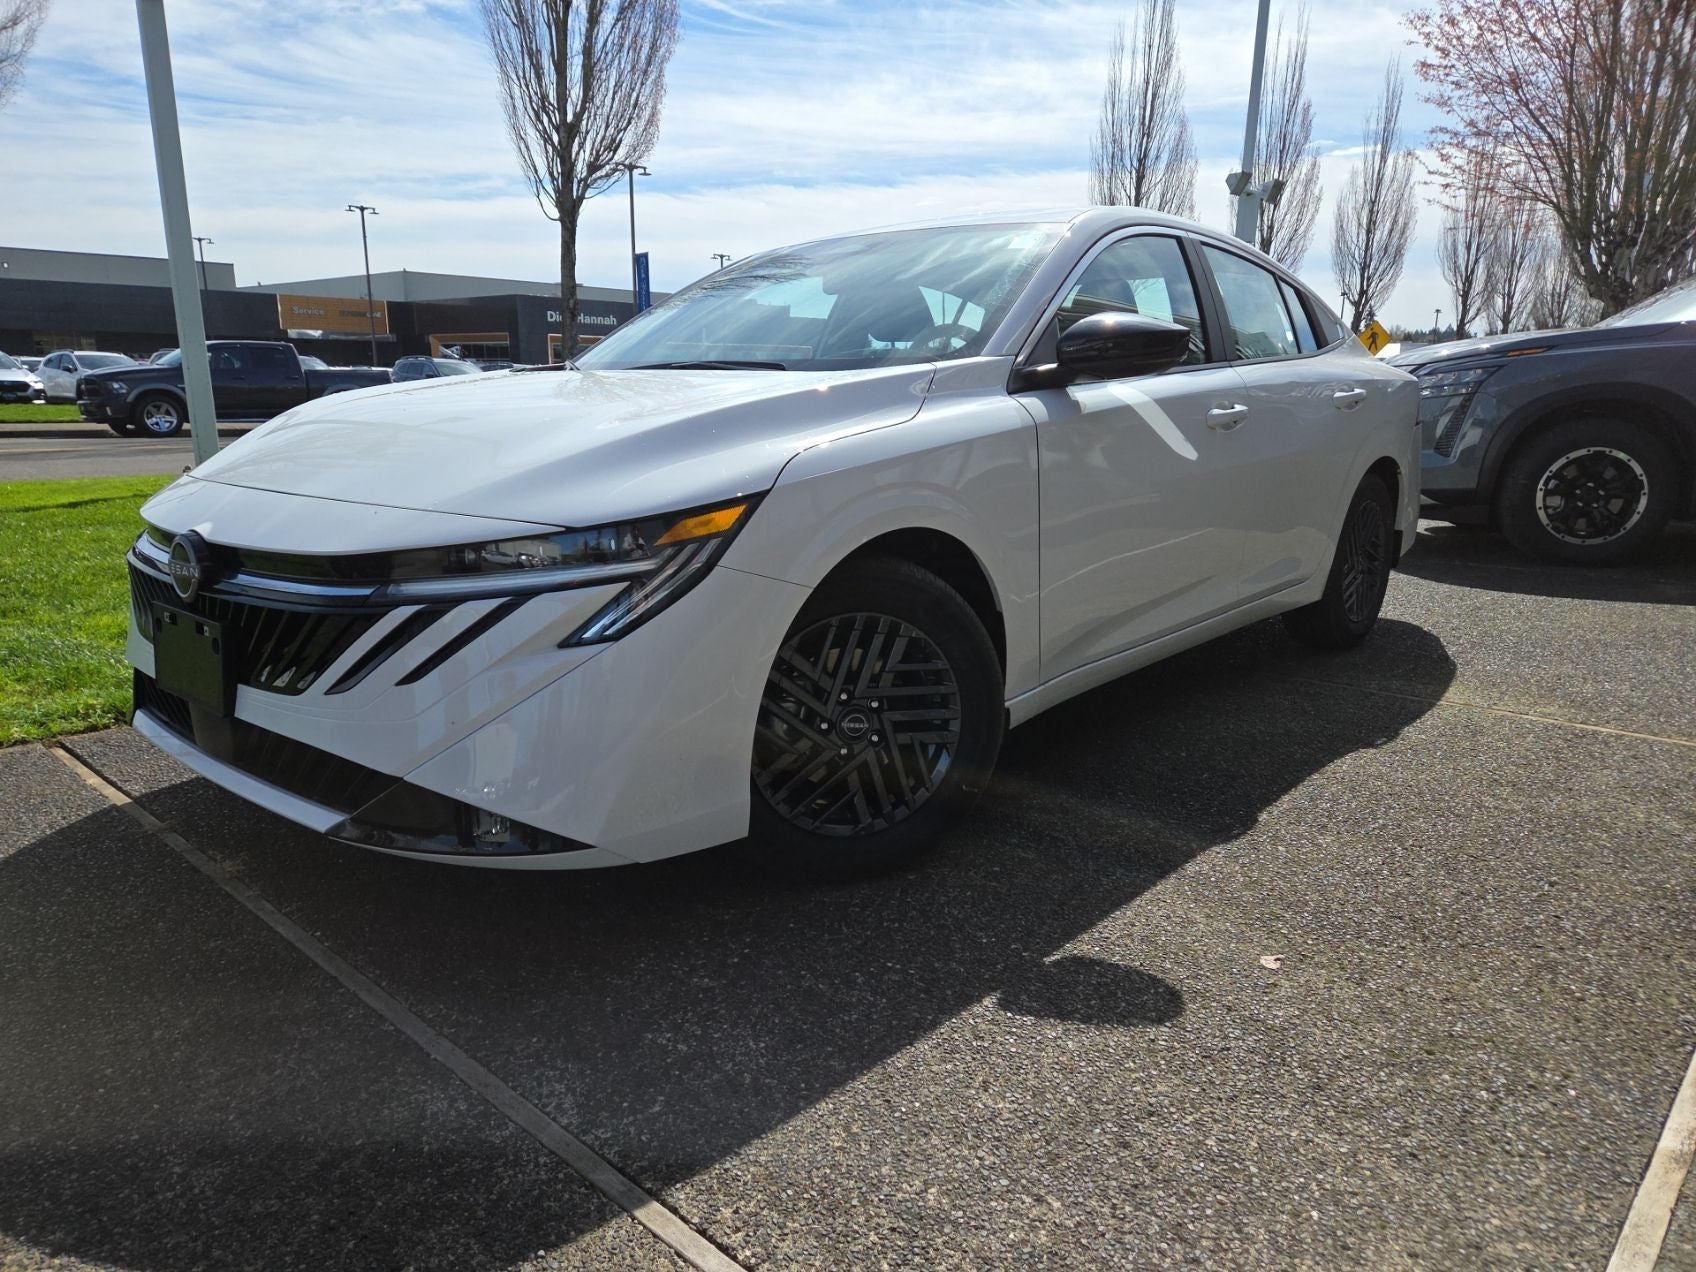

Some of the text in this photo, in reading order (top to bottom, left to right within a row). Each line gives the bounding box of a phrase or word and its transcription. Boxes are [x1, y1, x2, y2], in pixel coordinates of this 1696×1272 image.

[292, 305, 324, 315] Service
[547, 310, 617, 326] Di Hannah
